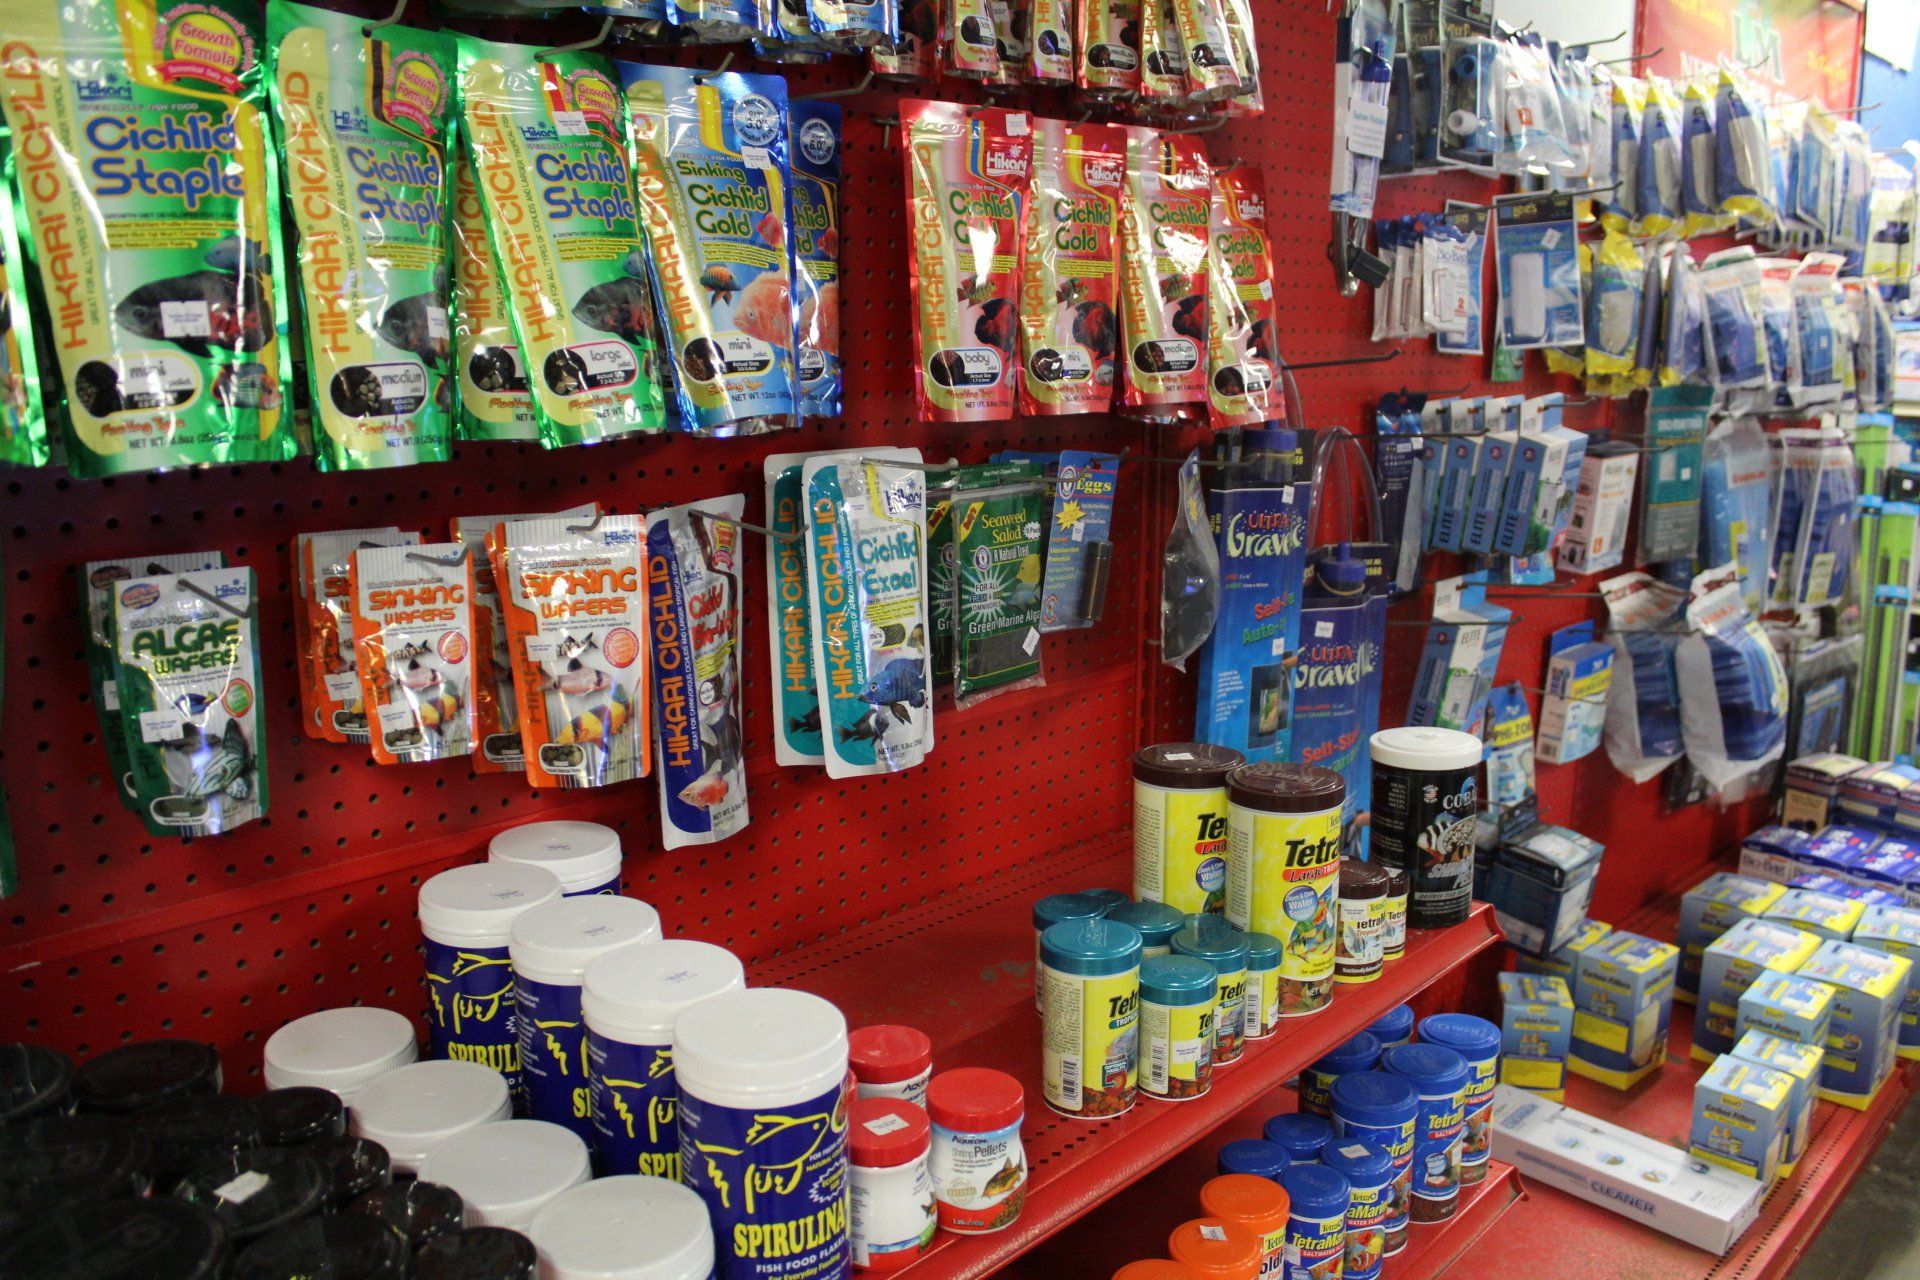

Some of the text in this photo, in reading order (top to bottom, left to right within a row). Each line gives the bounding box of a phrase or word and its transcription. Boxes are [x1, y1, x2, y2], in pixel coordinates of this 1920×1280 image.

[180, 21, 236, 48] Growth
[174, 38, 236, 67] Formula
[403, 68, 437, 94] Growth
[577, 83, 613, 101] Growth
[396, 83, 434, 111] Formula
[86, 113, 237, 151] Cichlid
[507, 130, 520, 158] TROPICAL
[518, 124, 559, 141] Hikari
[347, 145, 441, 187] Cichlid
[517, 159, 529, 187] LARGER
[536, 152, 626, 184] Cichlid
[676, 160, 746, 184] Sinking
[986, 147, 1029, 178] Hikari
[1085, 161, 1123, 187] Hikari
[93, 156, 246, 209] Staple
[524, 188, 533, 201] AND
[1, 41, 88, 350] HIKARI CICHLID
[543, 186, 636, 230] Staple
[687, 183, 768, 212] Cichlid
[949, 189, 1014, 218] Cichlid
[284, 71, 352, 354] HIKARI CICHLID
[472, 100, 555, 342] HIKARI CICHLID
[694, 210, 751, 237] Gold
[1053, 199, 1112, 227] Cichlid
[1150, 202, 1208, 226] Cichlid
[537, 234, 544, 242] OF
[1055, 226, 1098, 252] Gold
[1216, 234, 1263, 254] Cichlid
[540, 244, 550, 265] TYPES
[462, 228, 492, 335] HIKARI
[546, 268, 554, 280] ALL
[653, 233, 696, 333] HIKARI
[550, 283, 558, 296] FOR
[920, 256, 947, 342] HIKARI
[590, 350, 621, 363] large
[729, 338, 752, 351] mini
[964, 351, 990, 366] baby
[381, 369, 422, 386] medium
[732, 394, 747, 402] NET
[129, 440, 148, 450] NET
[1075, 478, 1112, 494] Eggs
[981, 508, 1027, 529] Seaweed
[1248, 512, 1289, 530] ULTRA
[1438, 511, 1455, 544] ELITE
[1469, 511, 1487, 546] ELITE
[1500, 511, 1518, 549] ELITE
[604, 530, 637, 545] Hikari
[992, 525, 1022, 544] Salad
[858, 531, 918, 565] Cichlid
[999, 546, 1017, 560] Natural
[215, 583, 247, 598] Hikari
[673, 576, 681, 604] TROPICAL
[862, 562, 917, 595] Excel
[975, 582, 1000, 592] FOR ALL
[368, 584, 465, 611] SINKING
[540, 597, 628, 619] WAFERS
[815, 497, 855, 699] HIKARI CICHLID
[384, 607, 456, 625] WAFERS
[851, 611, 856, 619] OF
[968, 614, 1024, 635] Green Marine
[131, 617, 242, 660] ALGAE
[784, 606, 807, 692] HIKARI
[1460, 628, 1481, 646] ELITE
[153, 648, 240, 675] WAFERS
[649, 554, 692, 767] HIKARI CICHLID
[1311, 645, 1353, 663] ULTRA
[686, 674, 695, 716] CARNIVOROUS
[1411, 701, 1428, 727] LITE
[1201, 869, 1223, 882] Water
[1289, 866, 1323, 884] Large
[1288, 898, 1314, 910] Water
[951, 1134, 988, 1146] AQUEON
[973, 1141, 1008, 1160] Pellets
[806, 1157, 832, 1172] NATURAL
[1352, 1192, 1370, 1203] Tetra
[1589, 1179, 1656, 1216] CLEANER
[734, 1199, 846, 1259] SPIRULINA
[1321, 1220, 1339, 1233] Tetra
[756, 1261, 783, 1274] FISH
[785, 1254, 817, 1271] FOOD
[1303, 1246, 1335, 1257] SALTWATER
